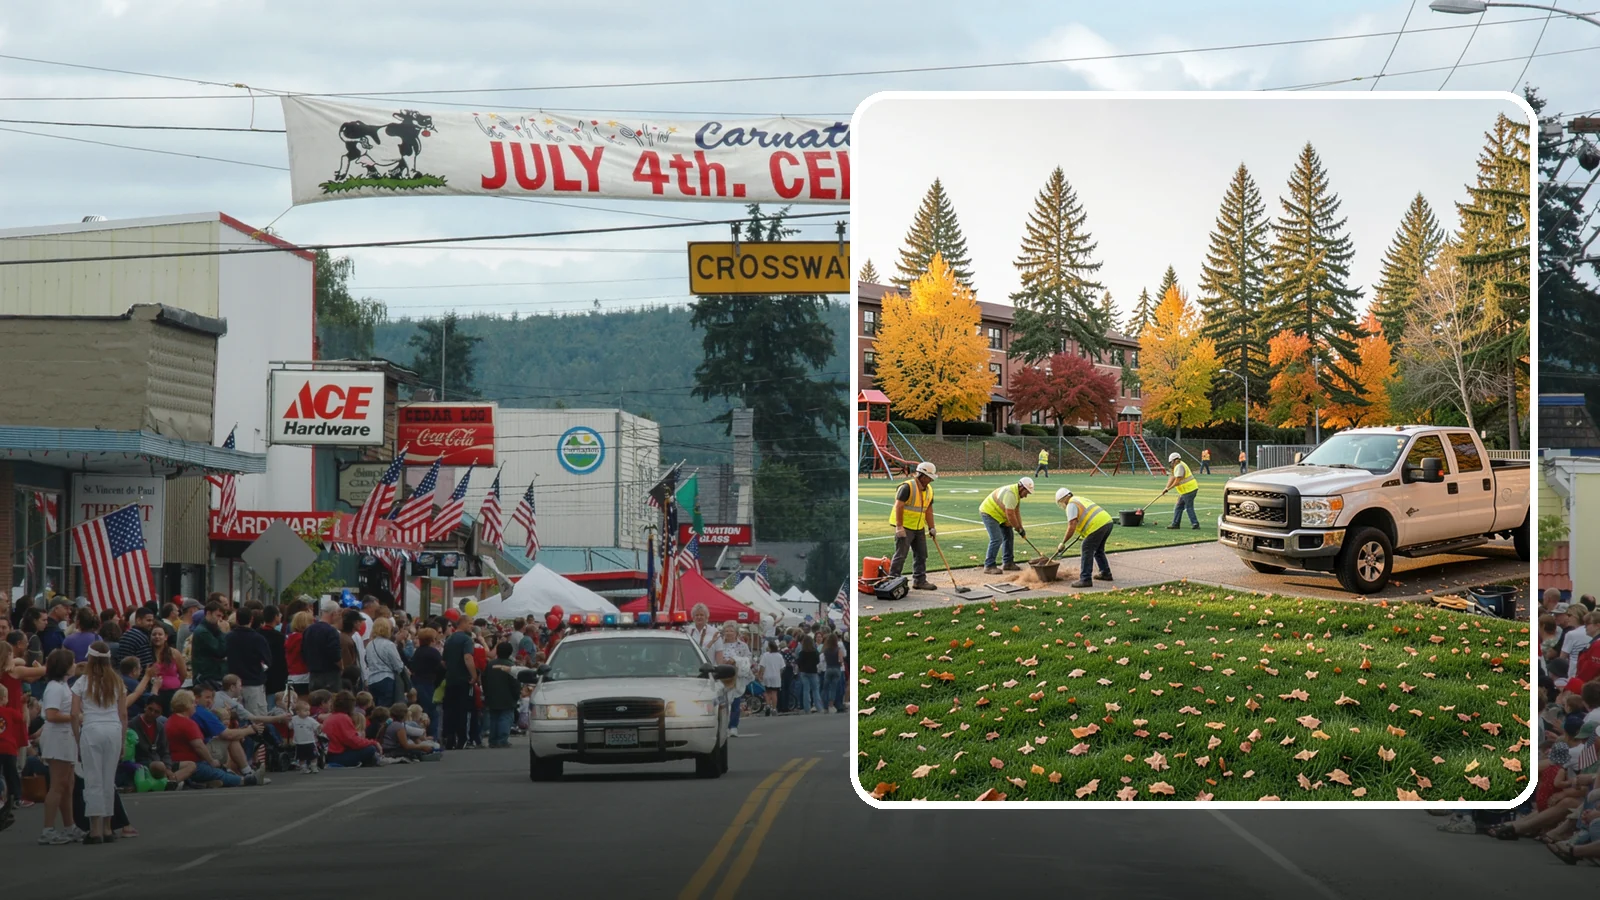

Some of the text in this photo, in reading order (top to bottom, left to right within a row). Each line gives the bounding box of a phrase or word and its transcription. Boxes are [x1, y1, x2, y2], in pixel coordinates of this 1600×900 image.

[695, 121, 850, 149] Carnat
[481, 141, 605, 192] JULY
[632, 150, 746, 197] 4th.
[697, 254, 850, 280] CROSSWA
[283, 380, 373, 419] ACE
[405, 409, 452, 421] CEDAR
[283, 421, 370, 436] Hardware
[416, 428, 477, 447] Coca-Cola
[95, 485, 124, 494] Vincent
[126, 486, 135, 494] de
[138, 486, 155, 495] Paul
[688, 526, 741, 535] CRNATION
[699, 535, 730, 543] GLASS
